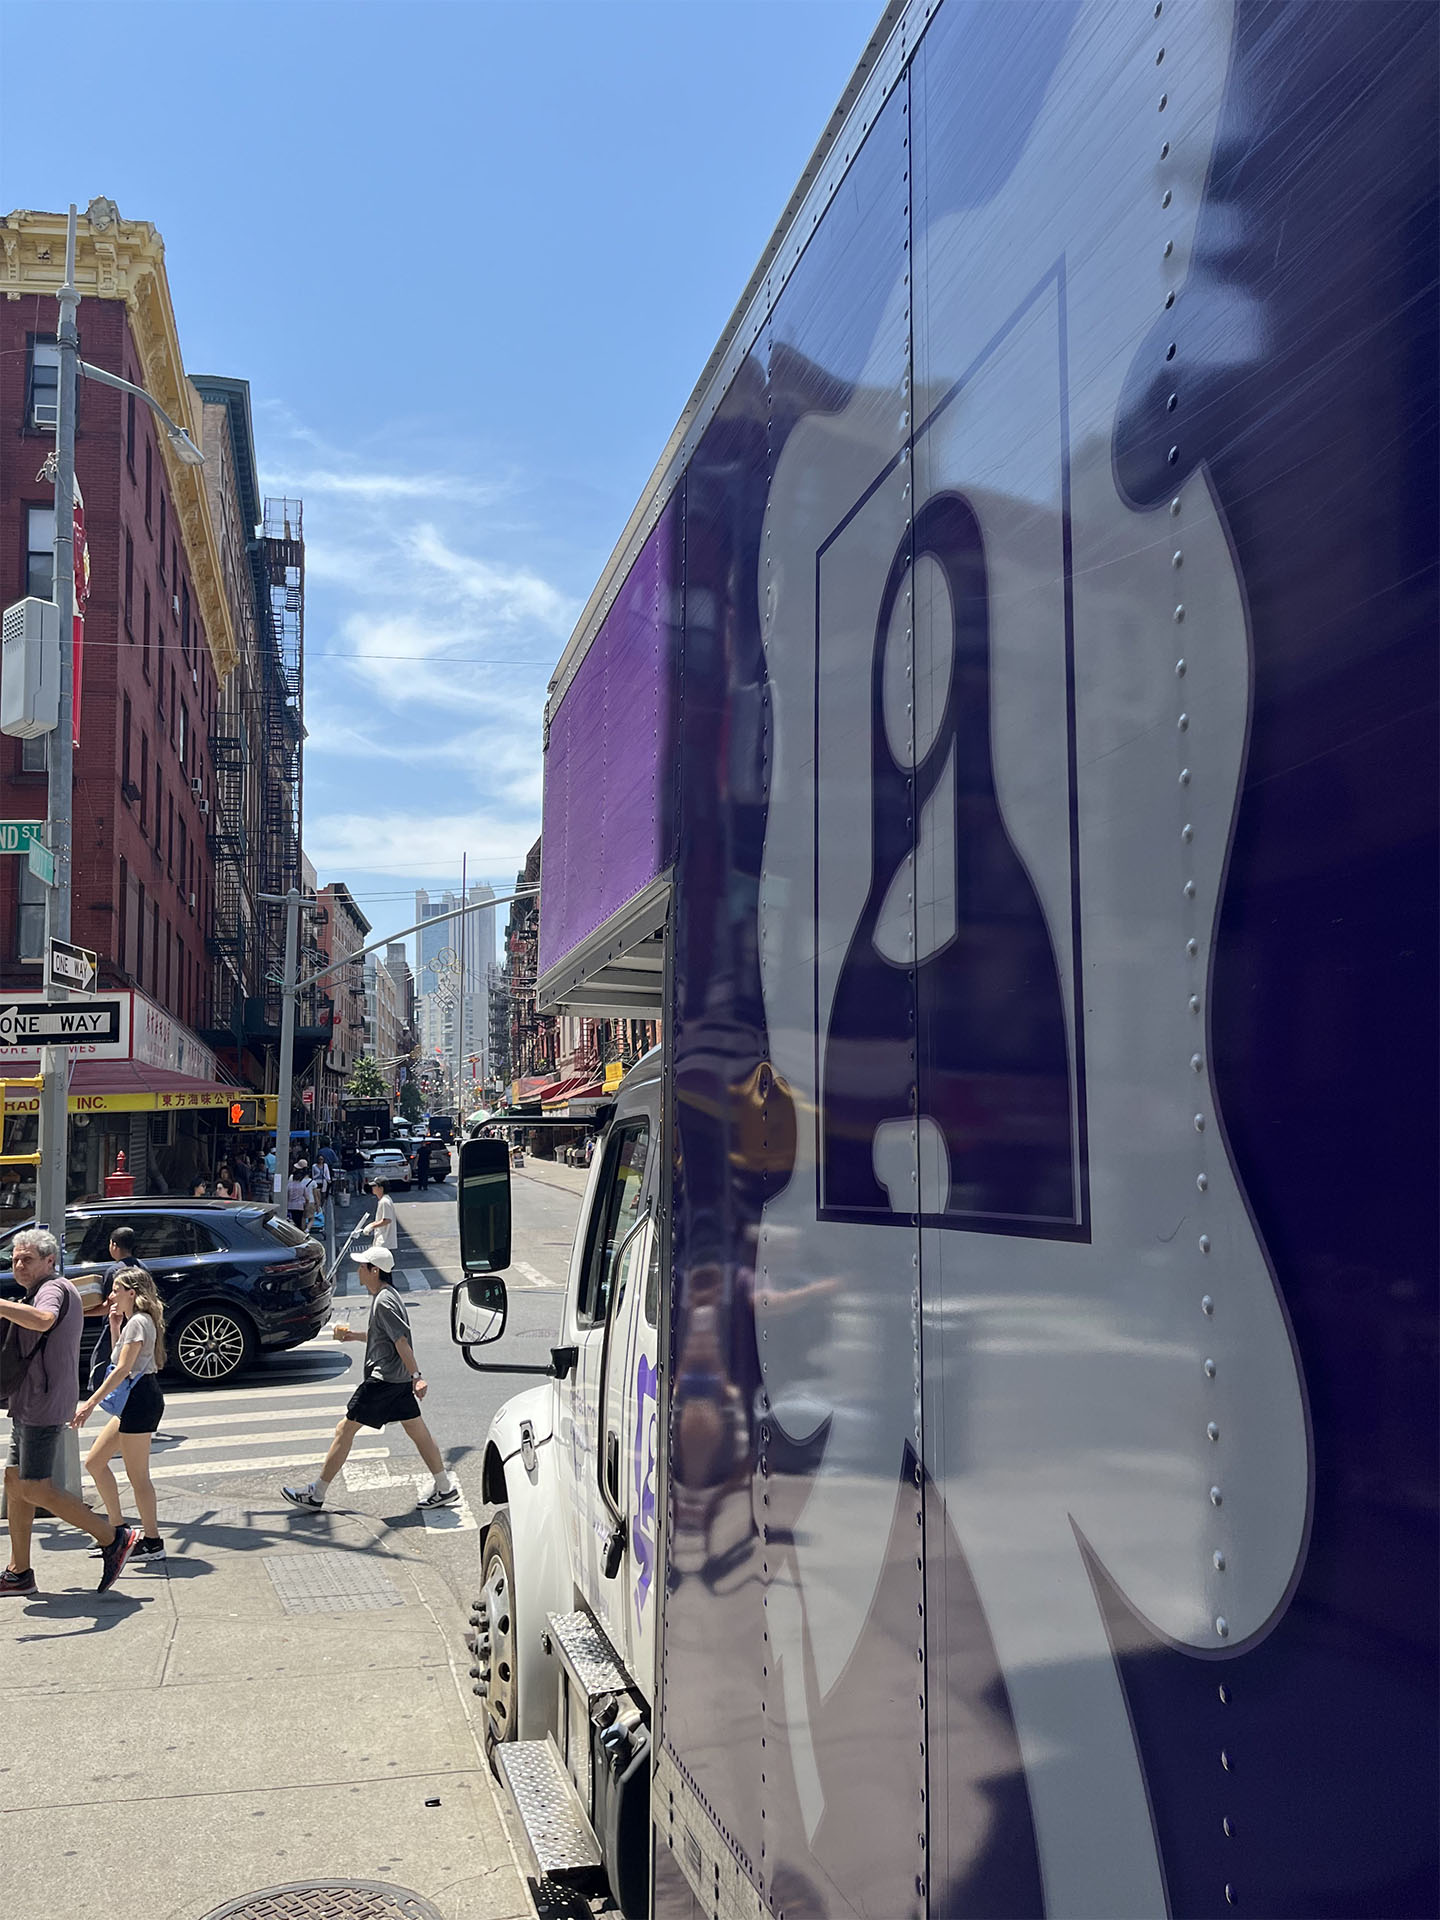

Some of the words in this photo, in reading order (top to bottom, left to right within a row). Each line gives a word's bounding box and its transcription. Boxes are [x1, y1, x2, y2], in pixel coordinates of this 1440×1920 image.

[22, 826, 39, 838] ST
[56, 955, 68, 974] ONE
[74, 960, 87, 979] WAY
[1, 1016, 40, 1033] ONE
[60, 1014, 102, 1032] WAY
[77, 1096, 107, 1110] INC.
